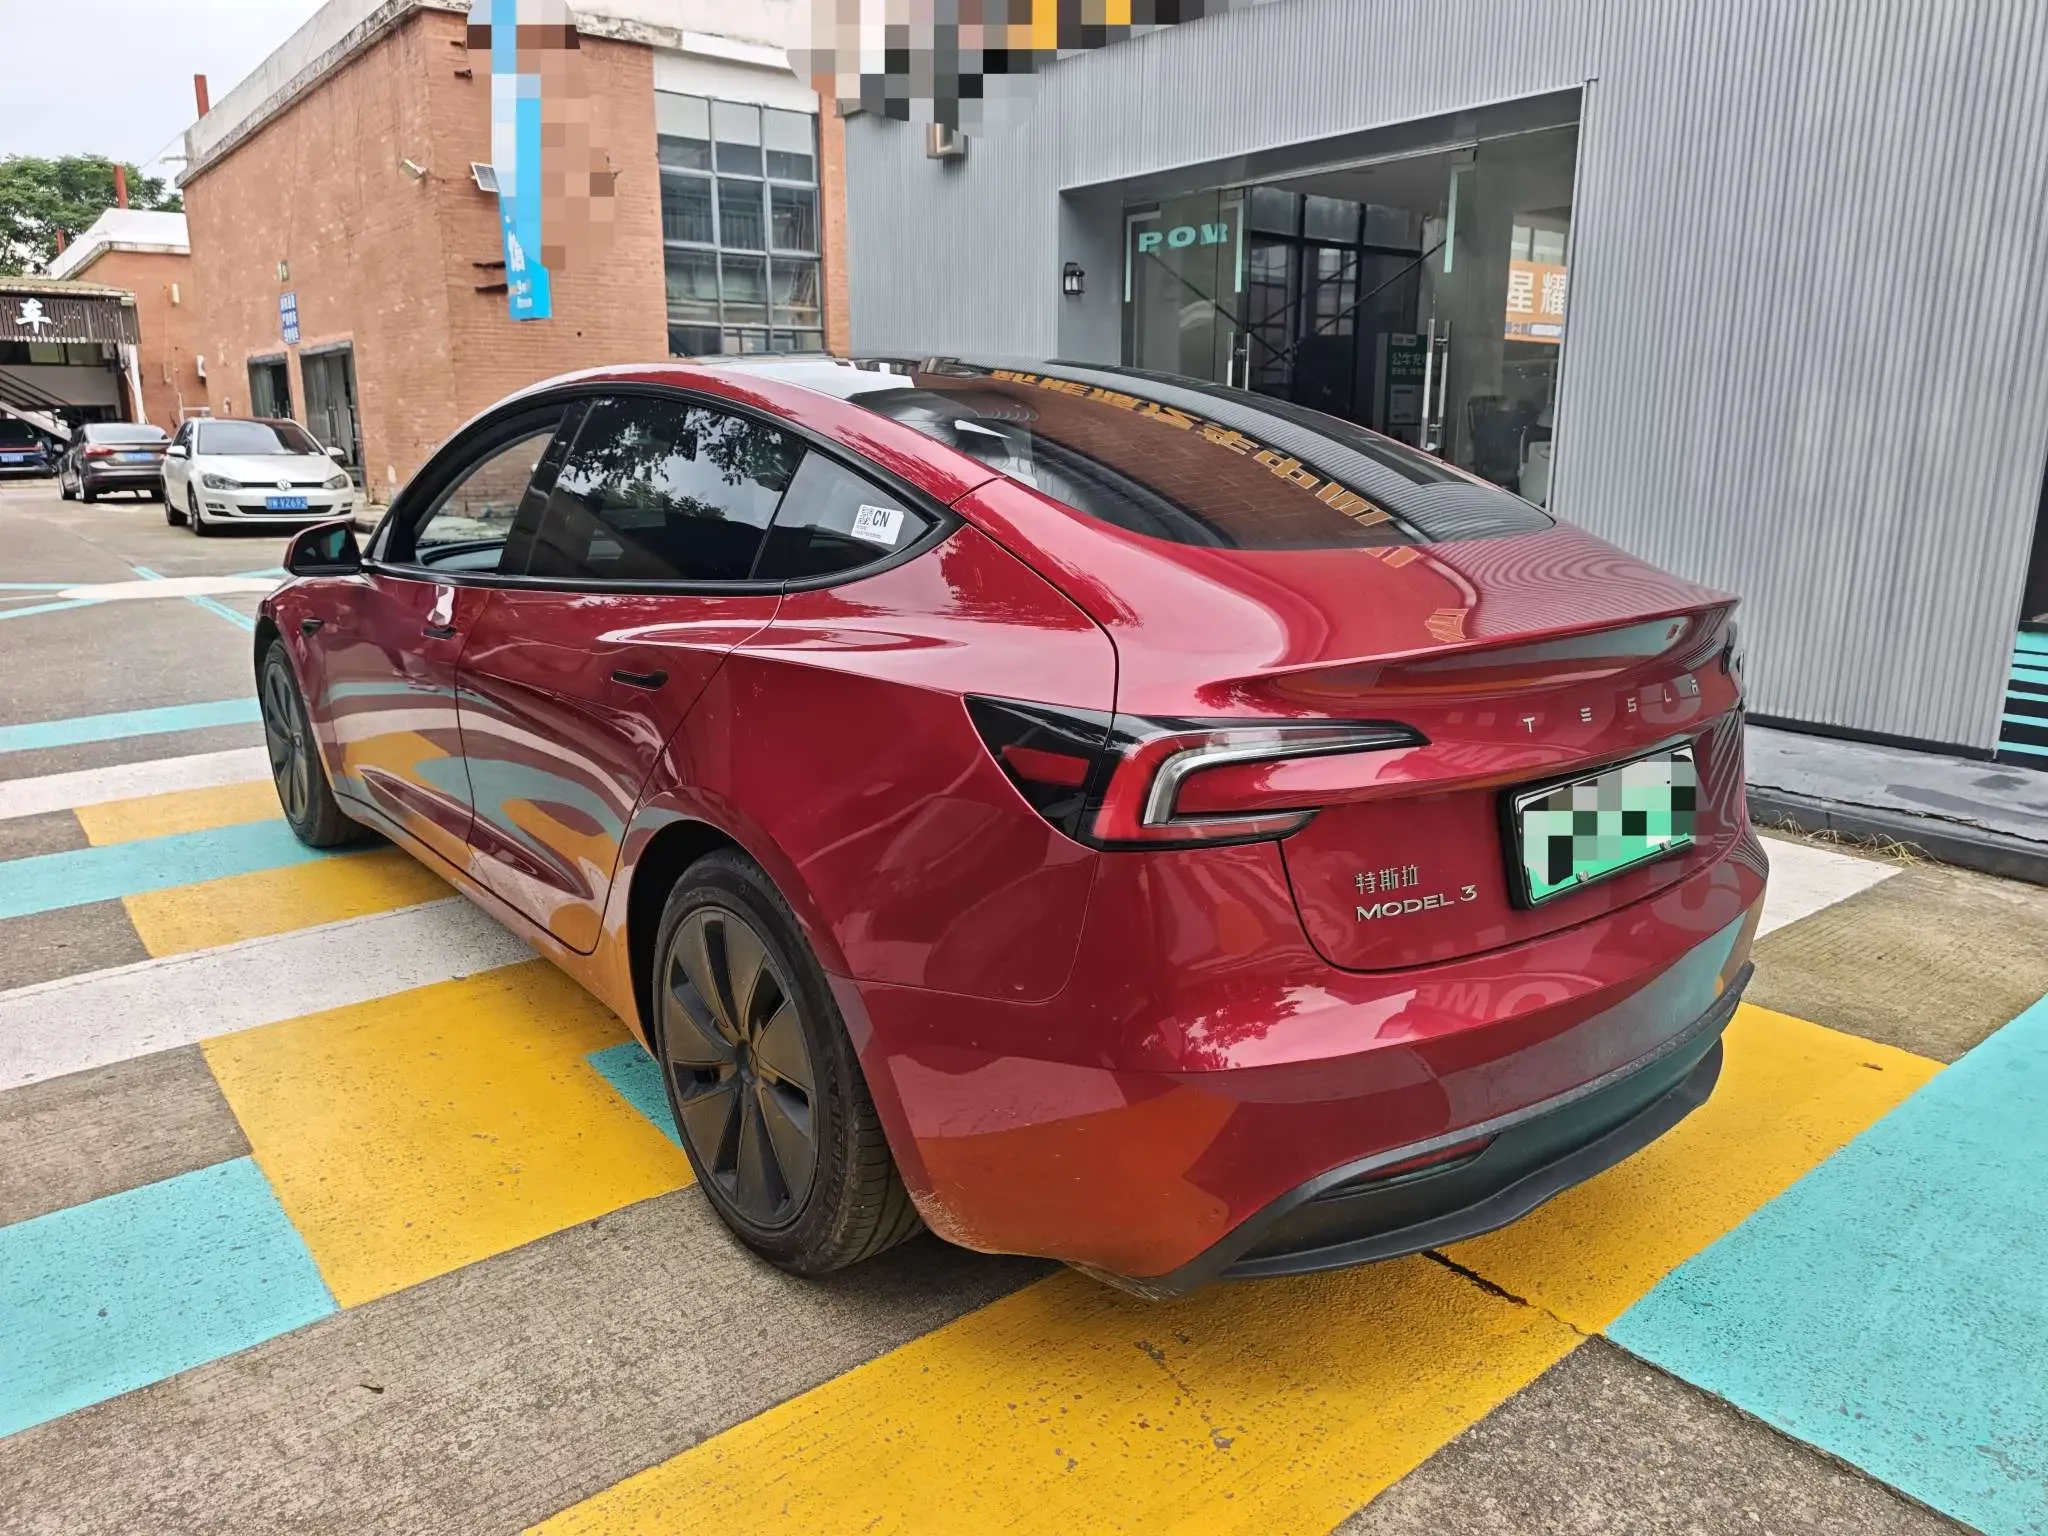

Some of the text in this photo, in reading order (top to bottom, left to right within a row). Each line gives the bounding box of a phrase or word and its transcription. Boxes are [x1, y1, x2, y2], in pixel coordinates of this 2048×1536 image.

[1506, 270, 1566, 315] 星耀
[873, 510, 890, 527] CN
[1522, 679, 1699, 733] TESLA
[1355, 864, 1420, 894] 特斯拉
[1356, 884, 1478, 922] MODEL 3
